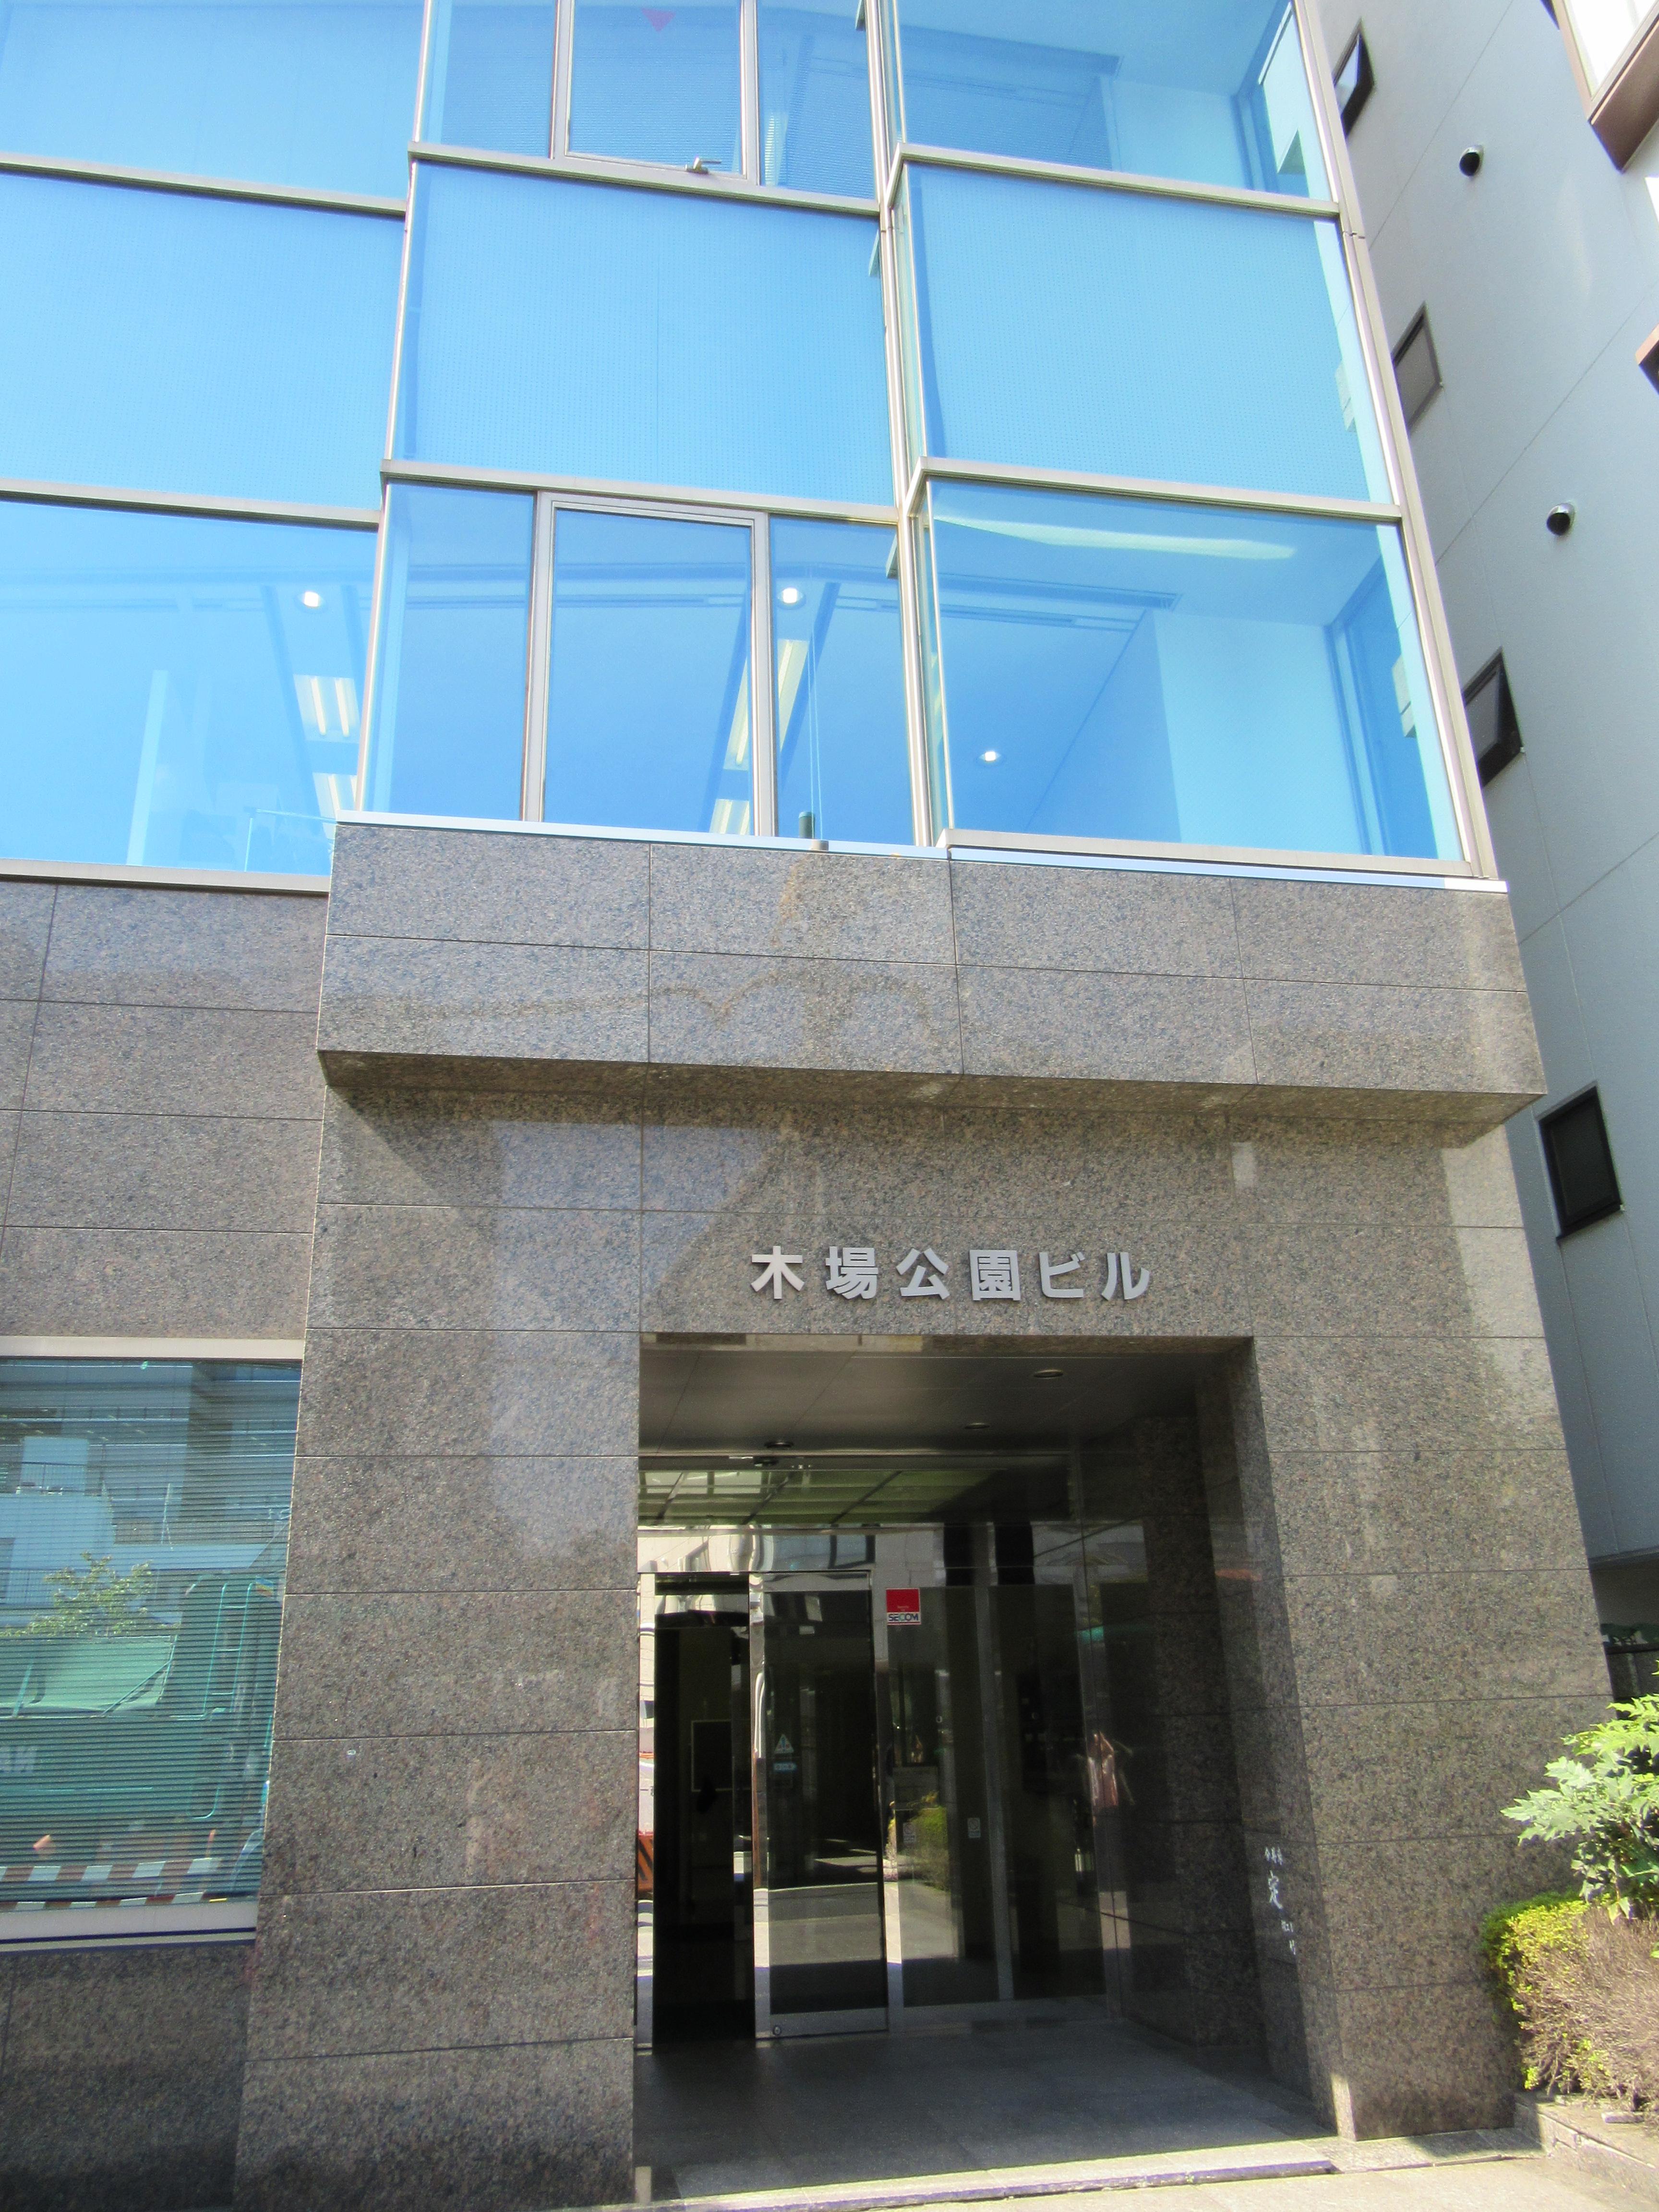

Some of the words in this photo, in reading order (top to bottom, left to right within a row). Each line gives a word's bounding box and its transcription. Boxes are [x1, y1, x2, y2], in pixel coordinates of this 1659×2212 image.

[750, 1245, 1150, 1301] 木場公園ビル
[889, 1613, 918, 1621] SECOM
